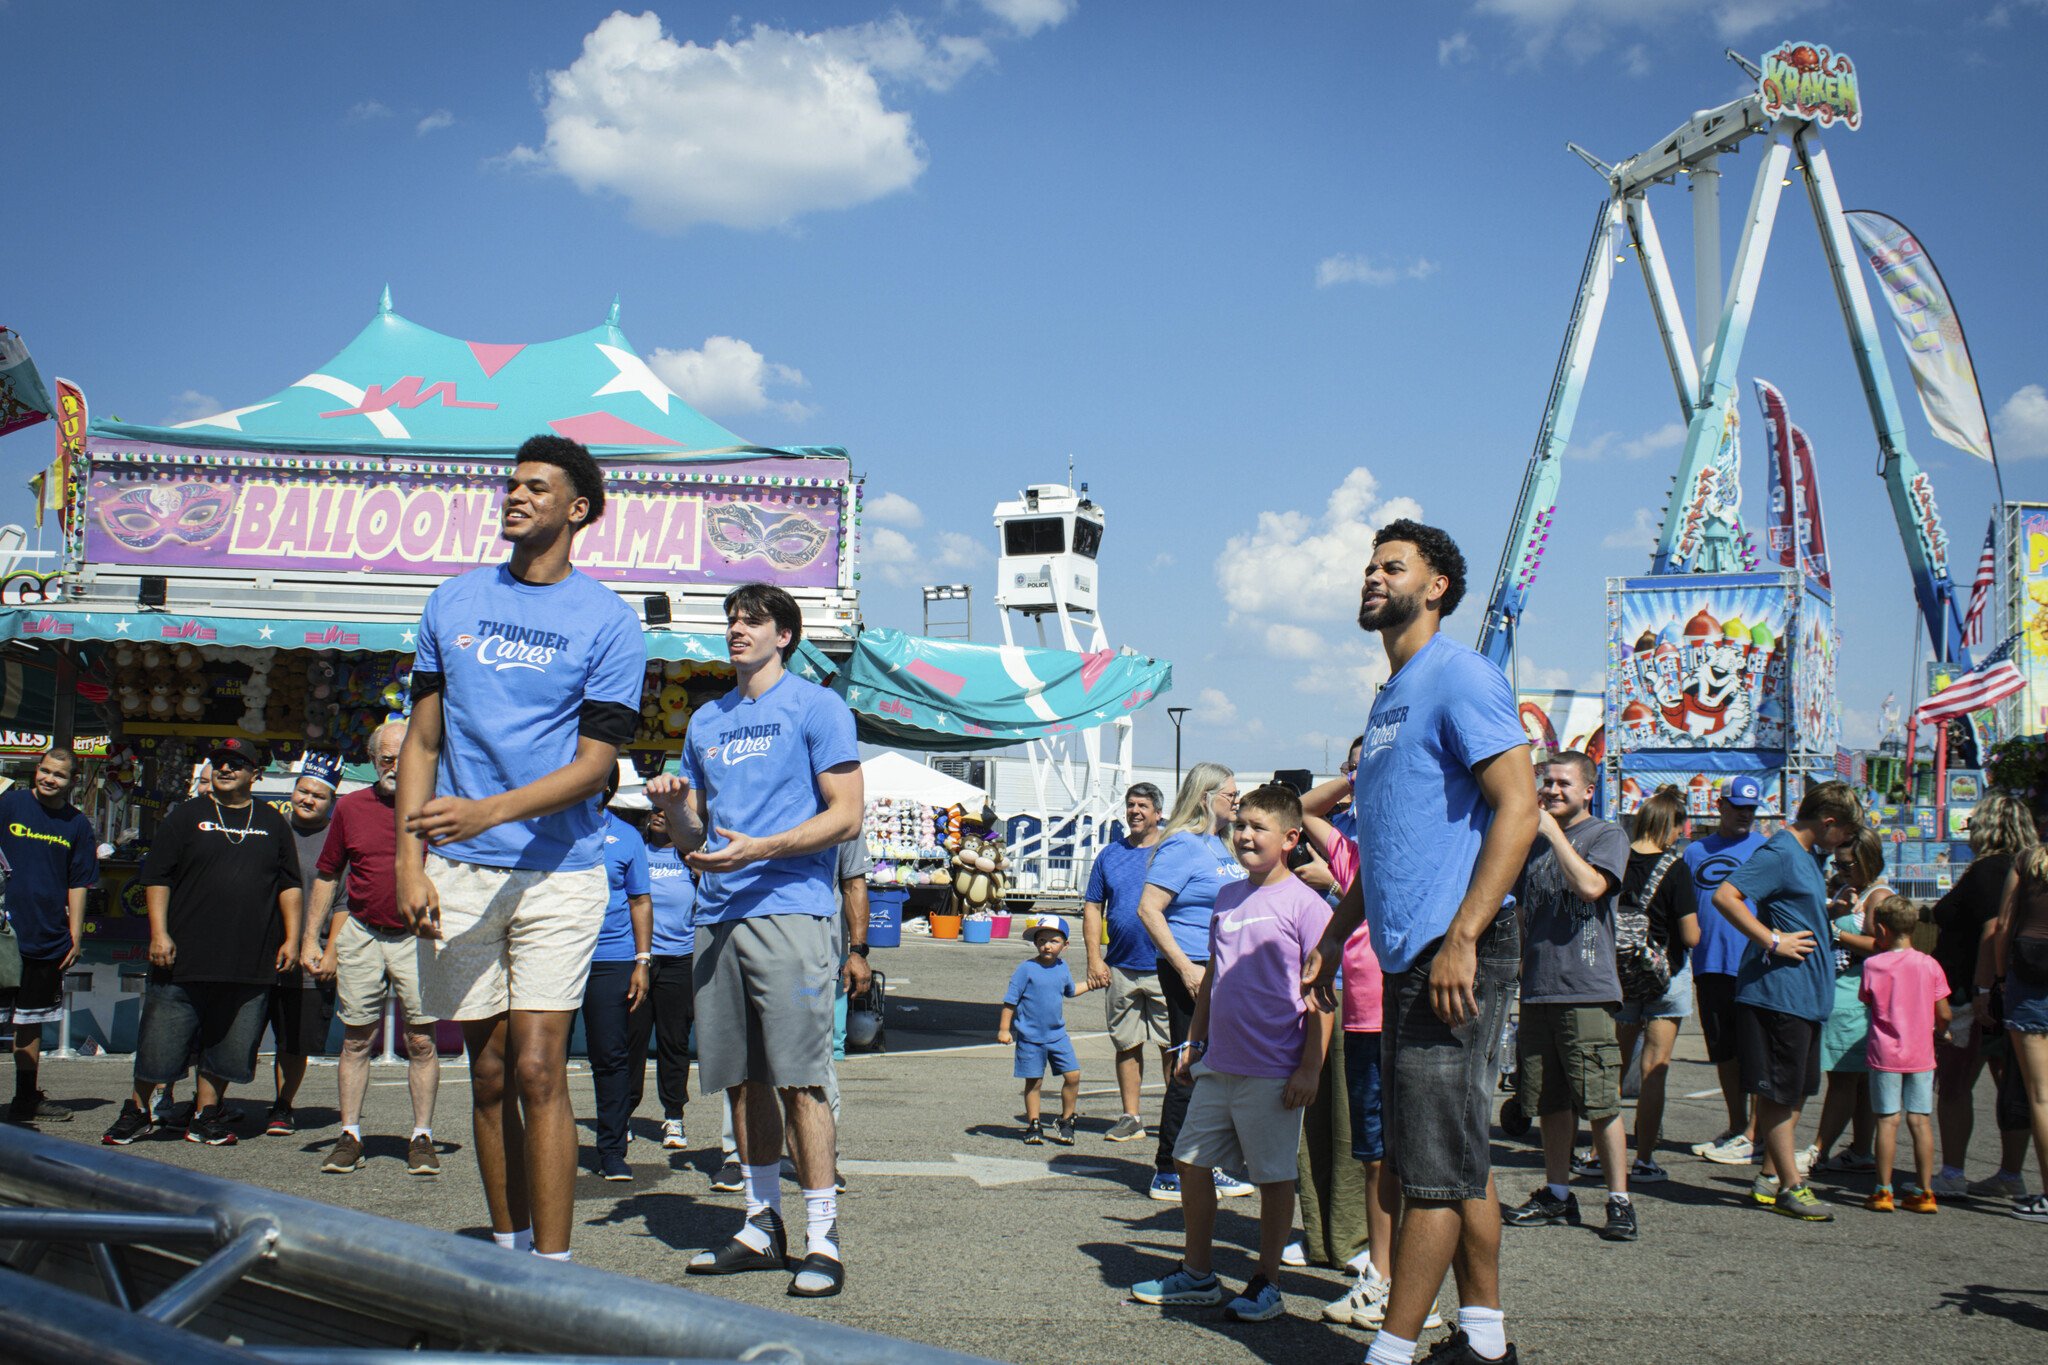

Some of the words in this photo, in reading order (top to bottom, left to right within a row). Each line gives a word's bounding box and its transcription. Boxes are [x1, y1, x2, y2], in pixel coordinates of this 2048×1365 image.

[1766, 56, 1859, 114] KRAKEN
[478, 619, 570, 652] THUNDER
[476, 634, 557, 666] Cares
[1621, 662, 1638, 680] CEE
[1746, 652, 1767, 674] CEE
[216, 687, 242, 695] PLAYE
[719, 723, 781, 745] THUNDER
[722, 736, 773, 766] Cares
[198, 821, 268, 838] Champion
